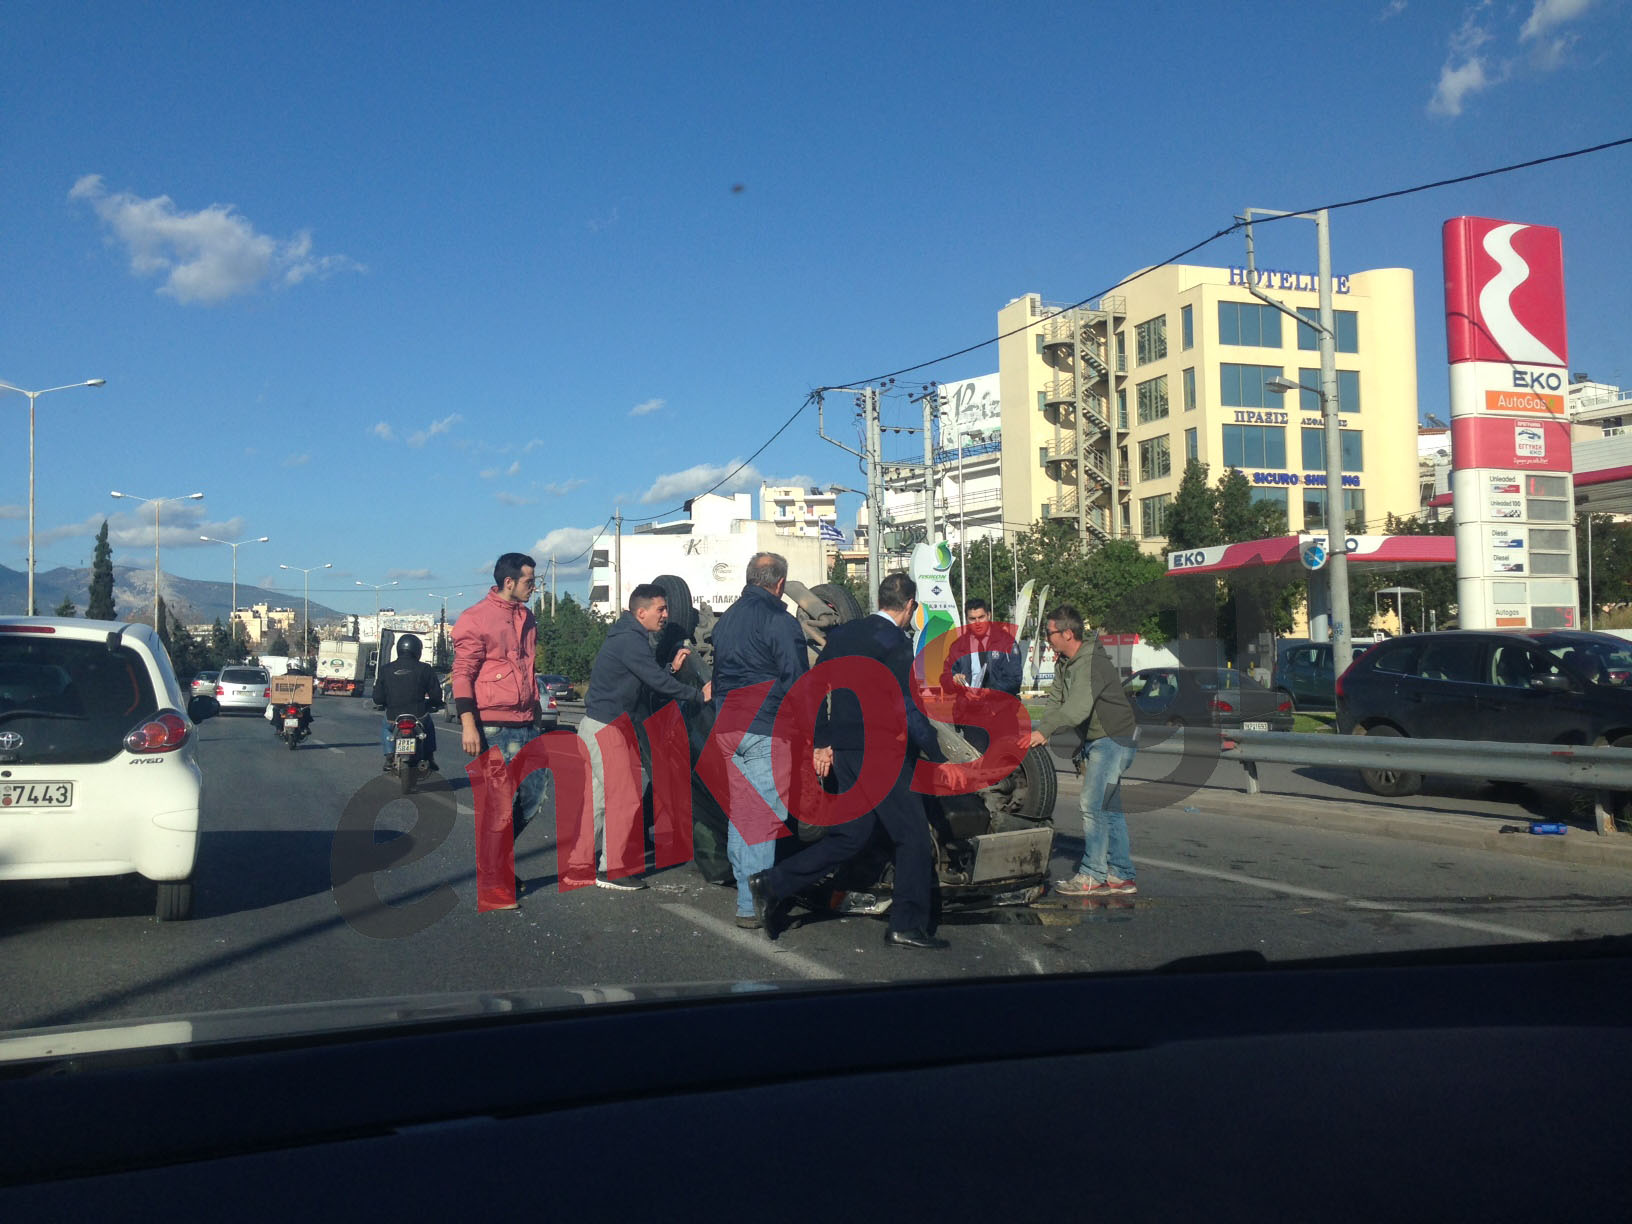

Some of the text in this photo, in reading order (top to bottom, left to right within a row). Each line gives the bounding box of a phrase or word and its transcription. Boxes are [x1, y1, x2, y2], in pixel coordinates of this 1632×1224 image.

[1229, 266, 1350, 294] HOTELIE
[1513, 370, 1561, 391] EKO
[1498, 394, 1546, 410] AutoGas
[1234, 410, 1288, 424] ΠΡΑΞΙΣ
[1173, 551, 1205, 567] EKO
[13, 785, 68, 805] 7443
